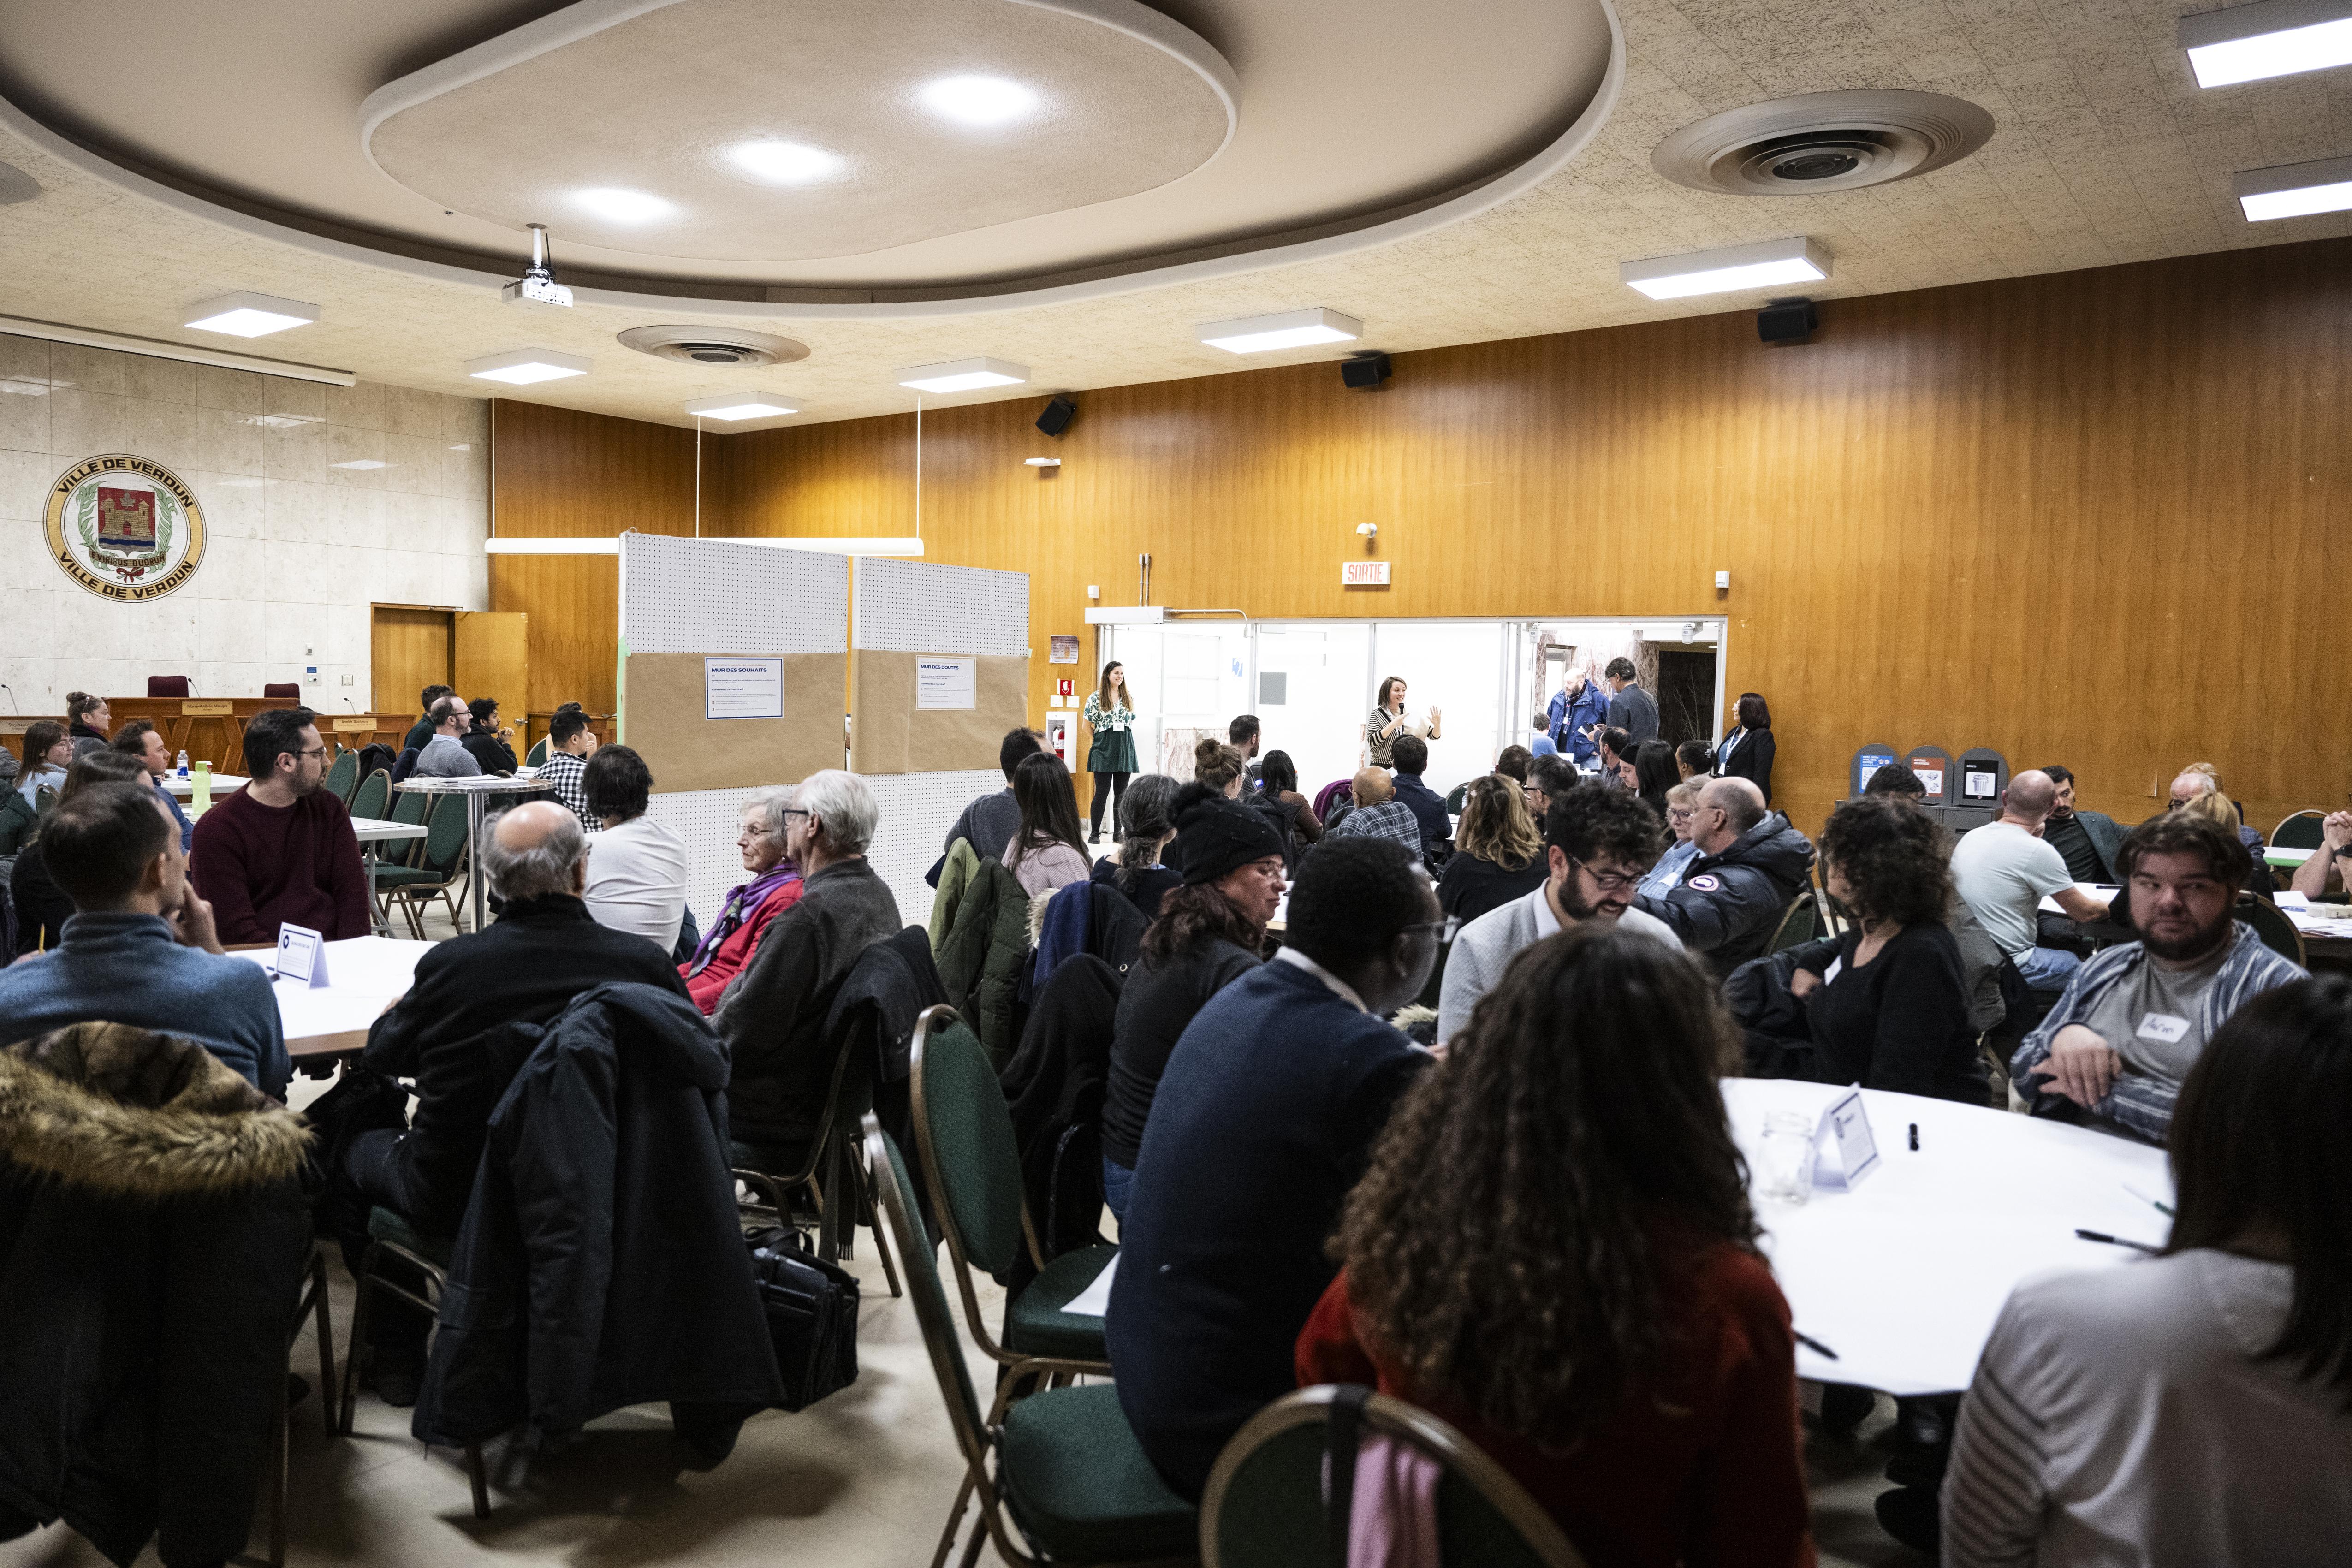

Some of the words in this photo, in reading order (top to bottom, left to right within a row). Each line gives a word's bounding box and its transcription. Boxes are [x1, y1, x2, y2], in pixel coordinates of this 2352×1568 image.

[57, 461, 99, 493] VILLE
[102, 458, 126, 469] DE
[131, 459, 194, 508] VERDUN
[60, 551, 100, 589] VILLE
[102, 586, 127, 598] DE
[132, 561, 194, 599] VERDUN
[98, 555, 128, 566] VIRIBUS
[132, 555, 166, 567] DUORUM
[1348, 564, 1383, 582] SORTIE
